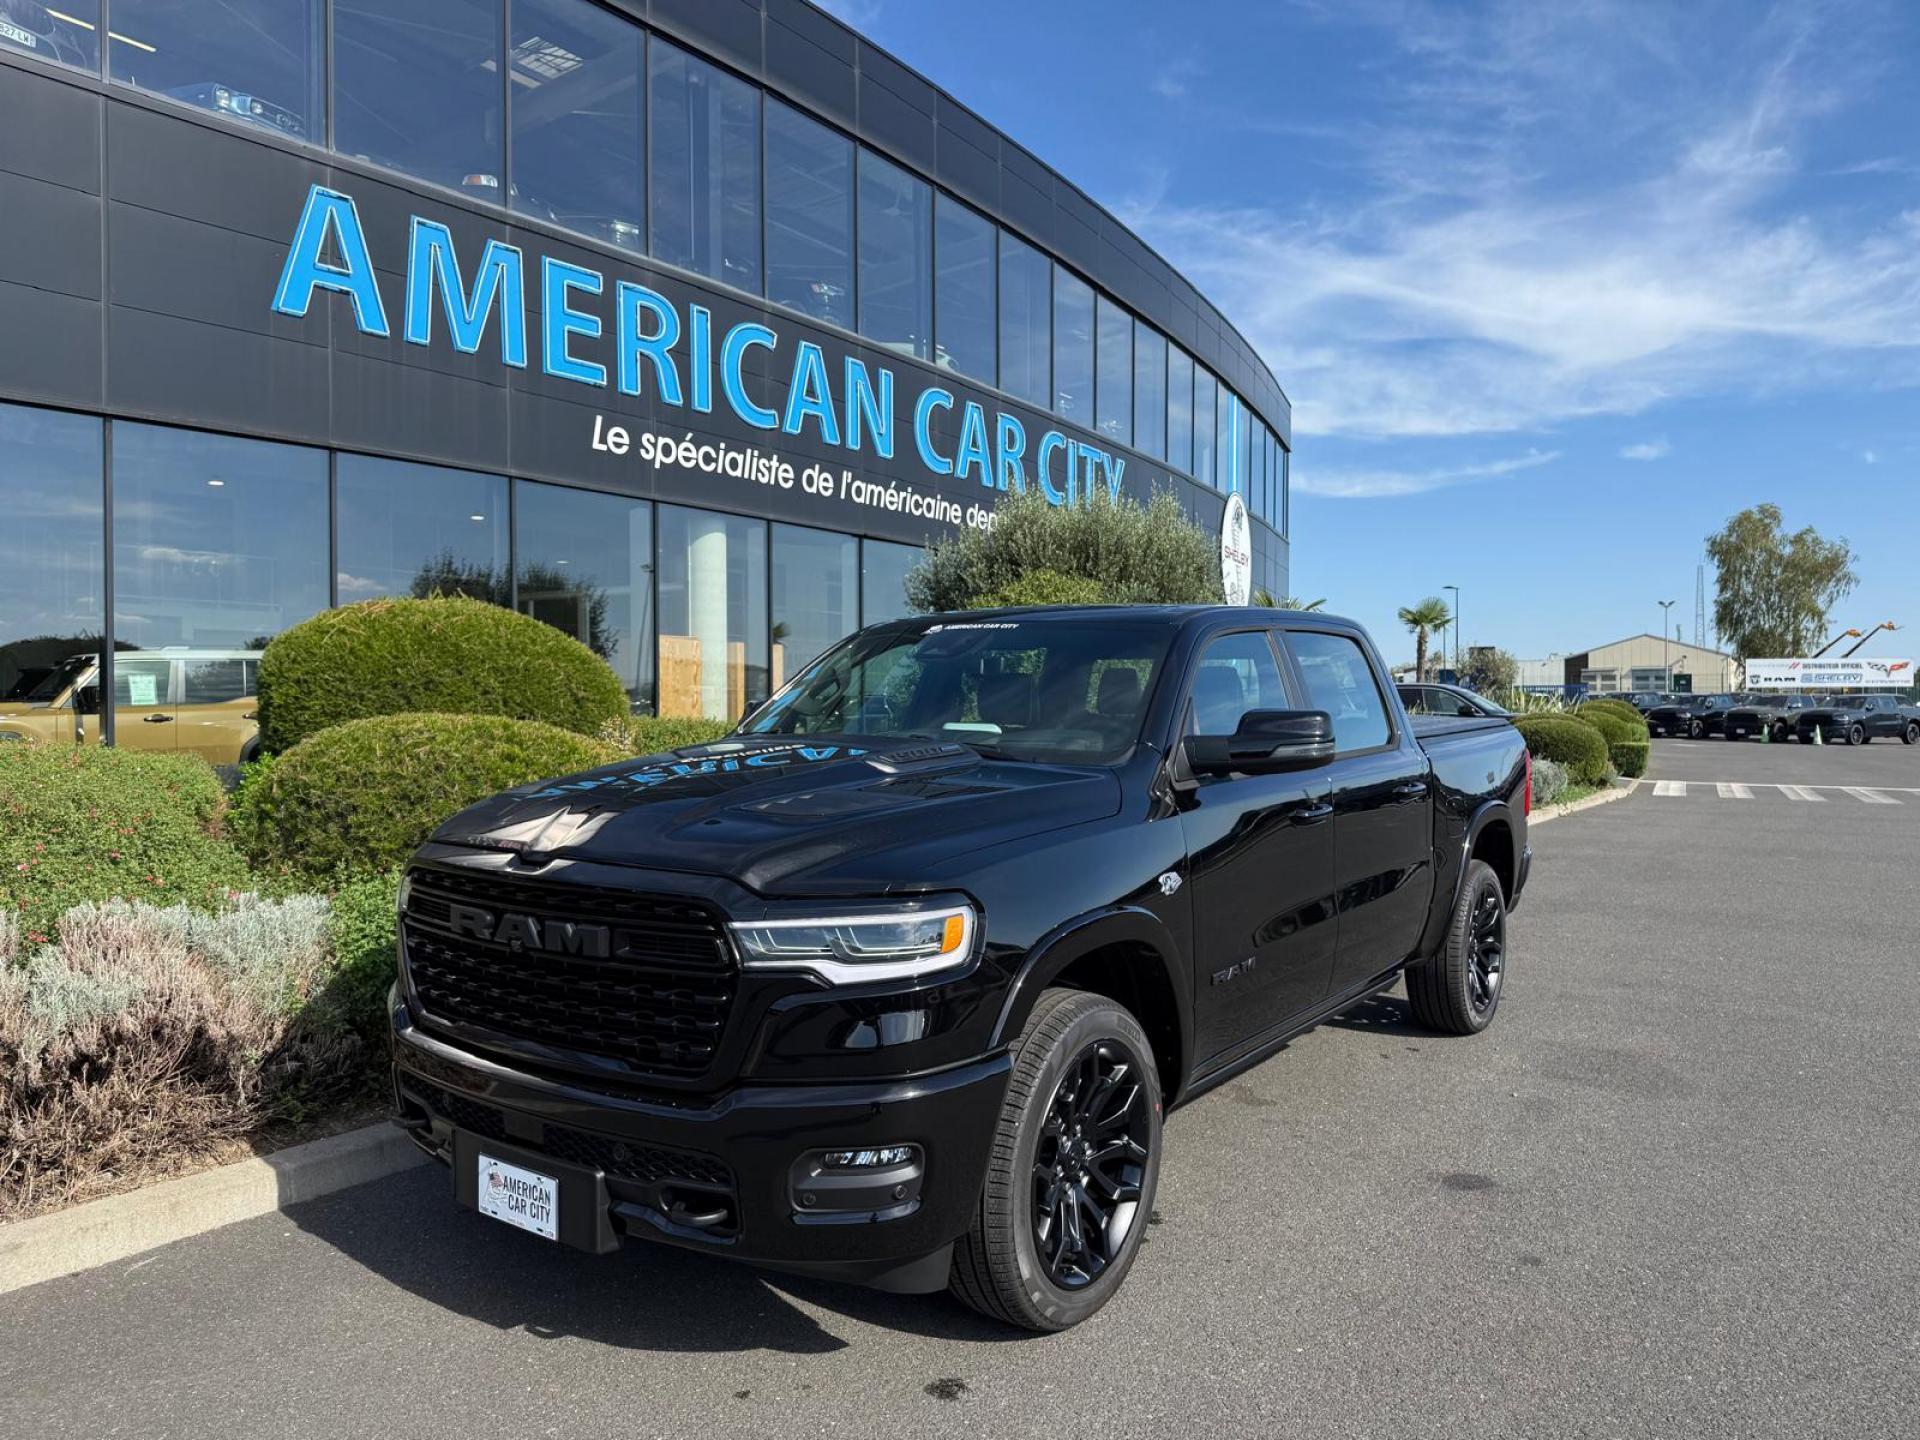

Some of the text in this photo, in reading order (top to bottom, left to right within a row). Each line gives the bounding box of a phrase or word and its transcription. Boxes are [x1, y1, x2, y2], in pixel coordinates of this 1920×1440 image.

[271, 183, 1126, 512] AMERICAN CAR CITY
[591, 413, 998, 532] Le spécialiste de l'américaine dep
[450, 903, 610, 958] RAM
[1211, 956, 1256, 986] RAM
[503, 1175, 551, 1207] AMERICAN
[508, 1194, 527, 1215] CAR
[529, 1202, 551, 1224] CITY
